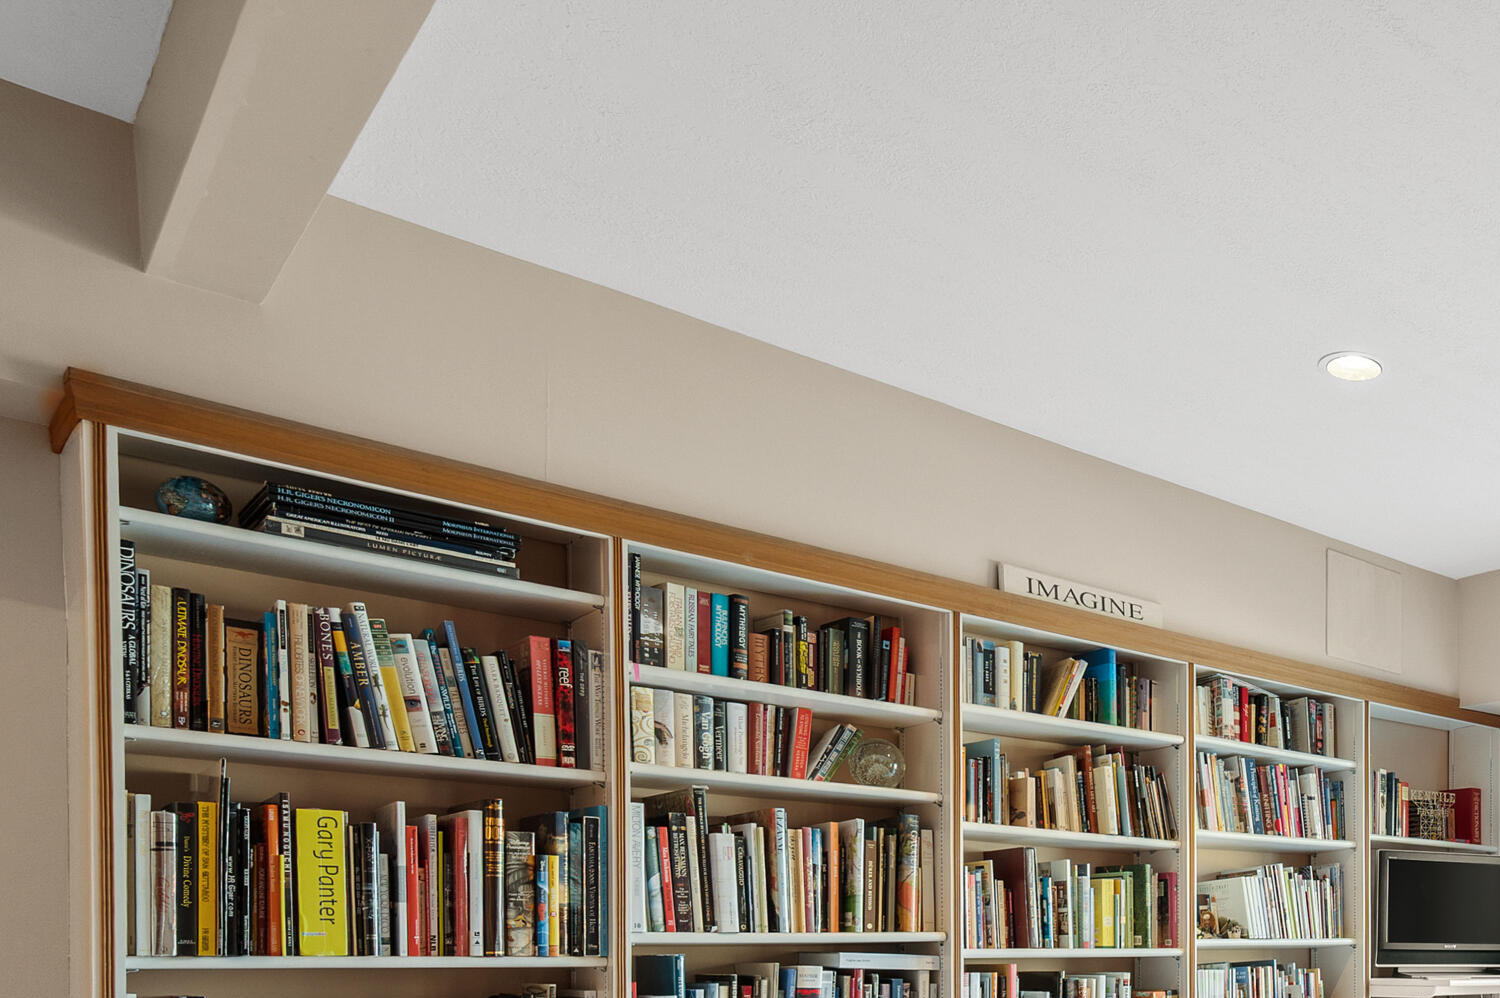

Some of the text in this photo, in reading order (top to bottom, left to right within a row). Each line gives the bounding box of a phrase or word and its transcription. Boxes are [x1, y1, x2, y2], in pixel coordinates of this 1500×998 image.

[326, 496, 391, 515] NECRONOMICON
[367, 542, 399, 554] LUMEN
[121, 546, 136, 629] DINOSAURS
[687, 593, 695, 622] RUSSIAN
[1026, 577, 1144, 621] IMAGINE
[320, 614, 334, 660] BONES
[687, 640, 695, 658] TALES
[238, 646, 253, 725] DINOSAURS
[350, 642, 370, 686] AMBER
[400, 657, 417, 694] evolution
[558, 667, 573, 689] reef
[698, 711, 712, 760] Van Gogh
[714, 725, 725, 762] Vermeer
[631, 805, 640, 869] MILTON AVERY
[181, 855, 192, 908] Divine Comedy
[313, 816, 339, 925] Gary Panter
